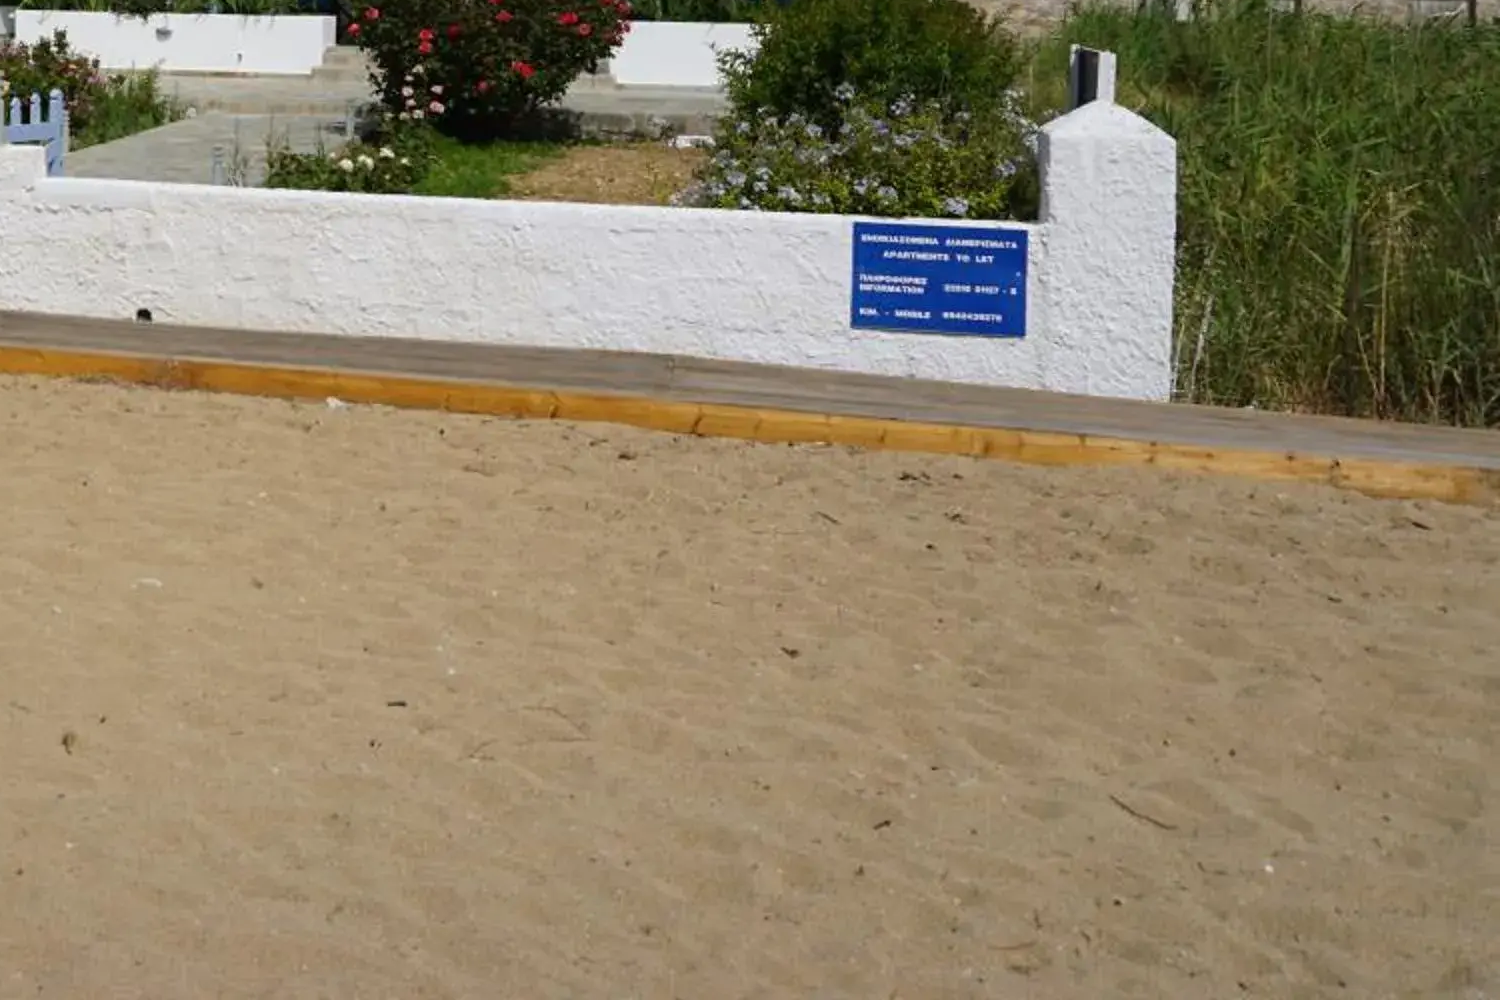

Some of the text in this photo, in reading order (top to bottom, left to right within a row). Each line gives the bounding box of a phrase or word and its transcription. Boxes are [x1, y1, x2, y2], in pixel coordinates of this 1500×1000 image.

[883, 250, 995, 264] APARTMENTS TO LET
[859, 283, 925, 295] INFORMATION
